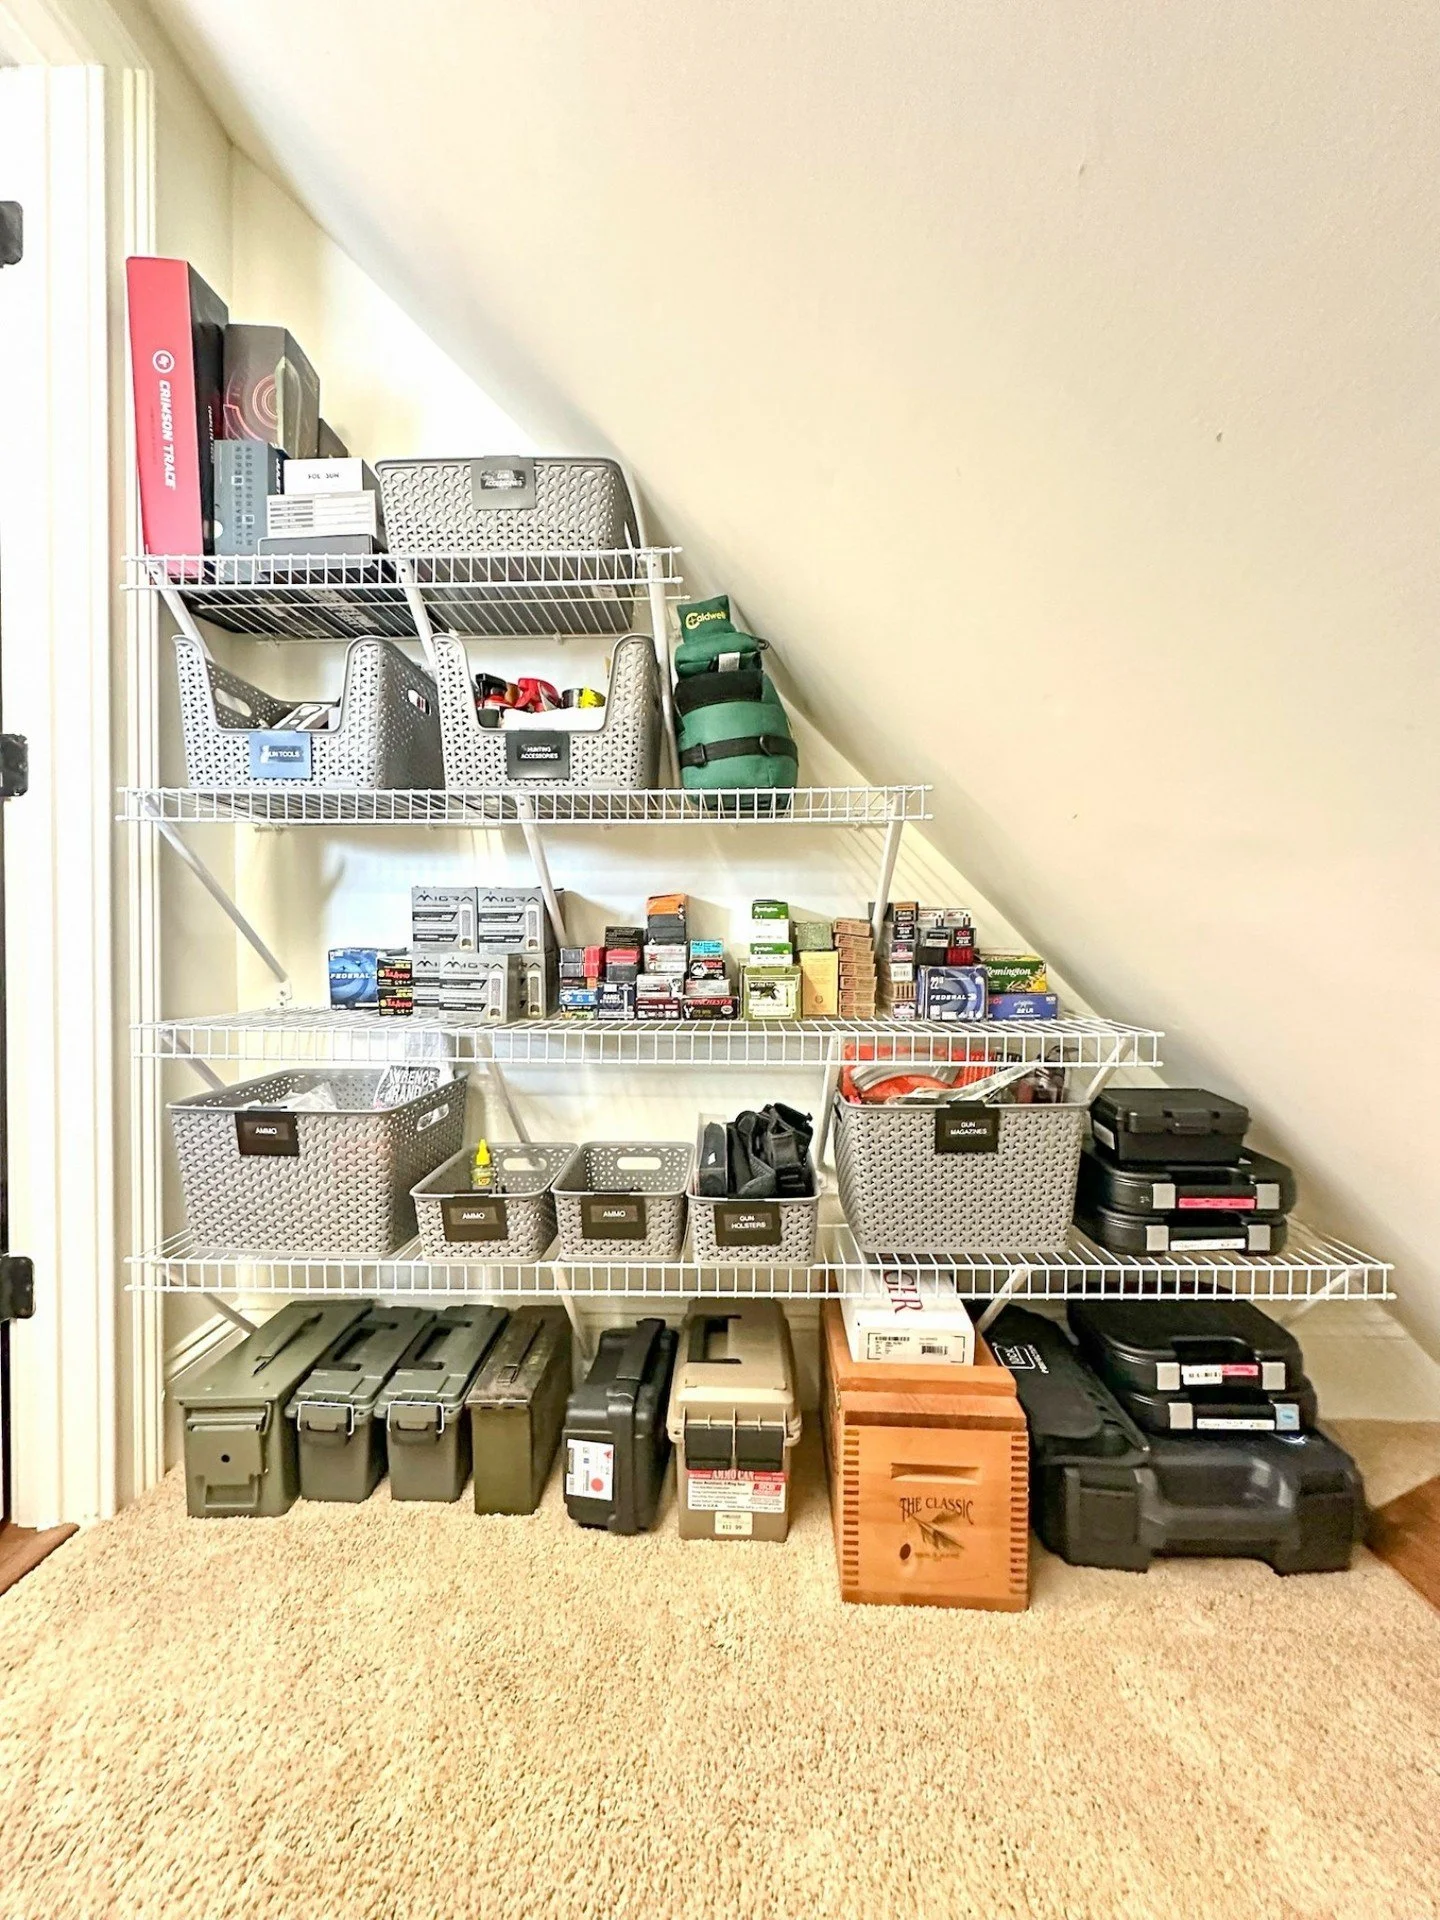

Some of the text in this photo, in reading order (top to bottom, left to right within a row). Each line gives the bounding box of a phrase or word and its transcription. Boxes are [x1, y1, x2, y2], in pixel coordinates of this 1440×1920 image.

[158, 379, 176, 490] CRIMSON TRACE
[686, 611, 726, 630] Caldwell
[986, 966, 1032, 978] Remington
[712, 1470, 754, 1480] AMMO CAN
[900, 1496, 974, 1526] THE CLASSIC
